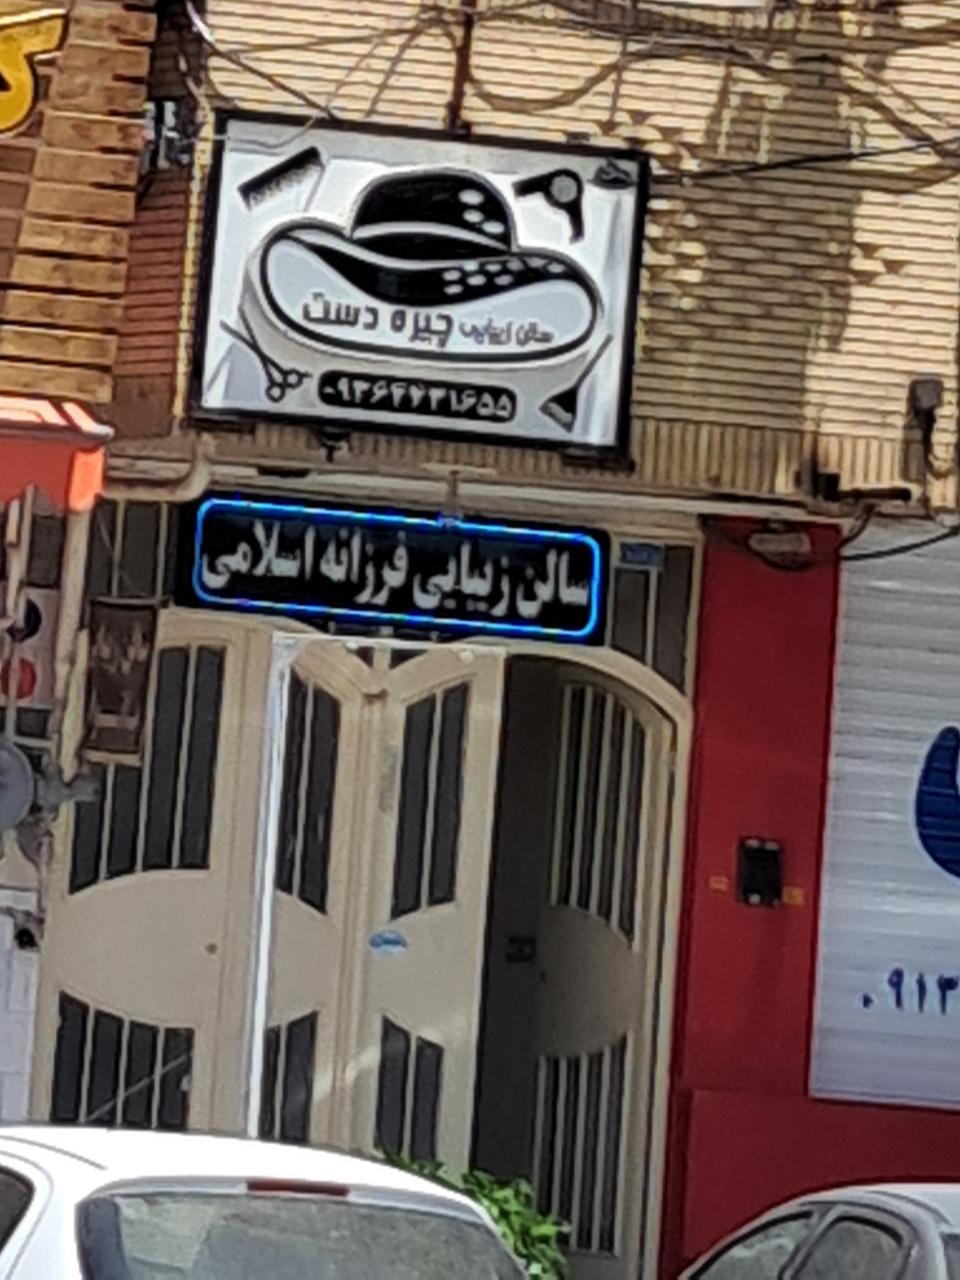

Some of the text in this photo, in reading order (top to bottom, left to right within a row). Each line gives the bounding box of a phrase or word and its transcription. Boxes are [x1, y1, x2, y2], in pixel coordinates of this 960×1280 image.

[302, 292, 380, 330] دست
[202, 519, 589, 619] سالن زیبایی فرزانه اسلامی
